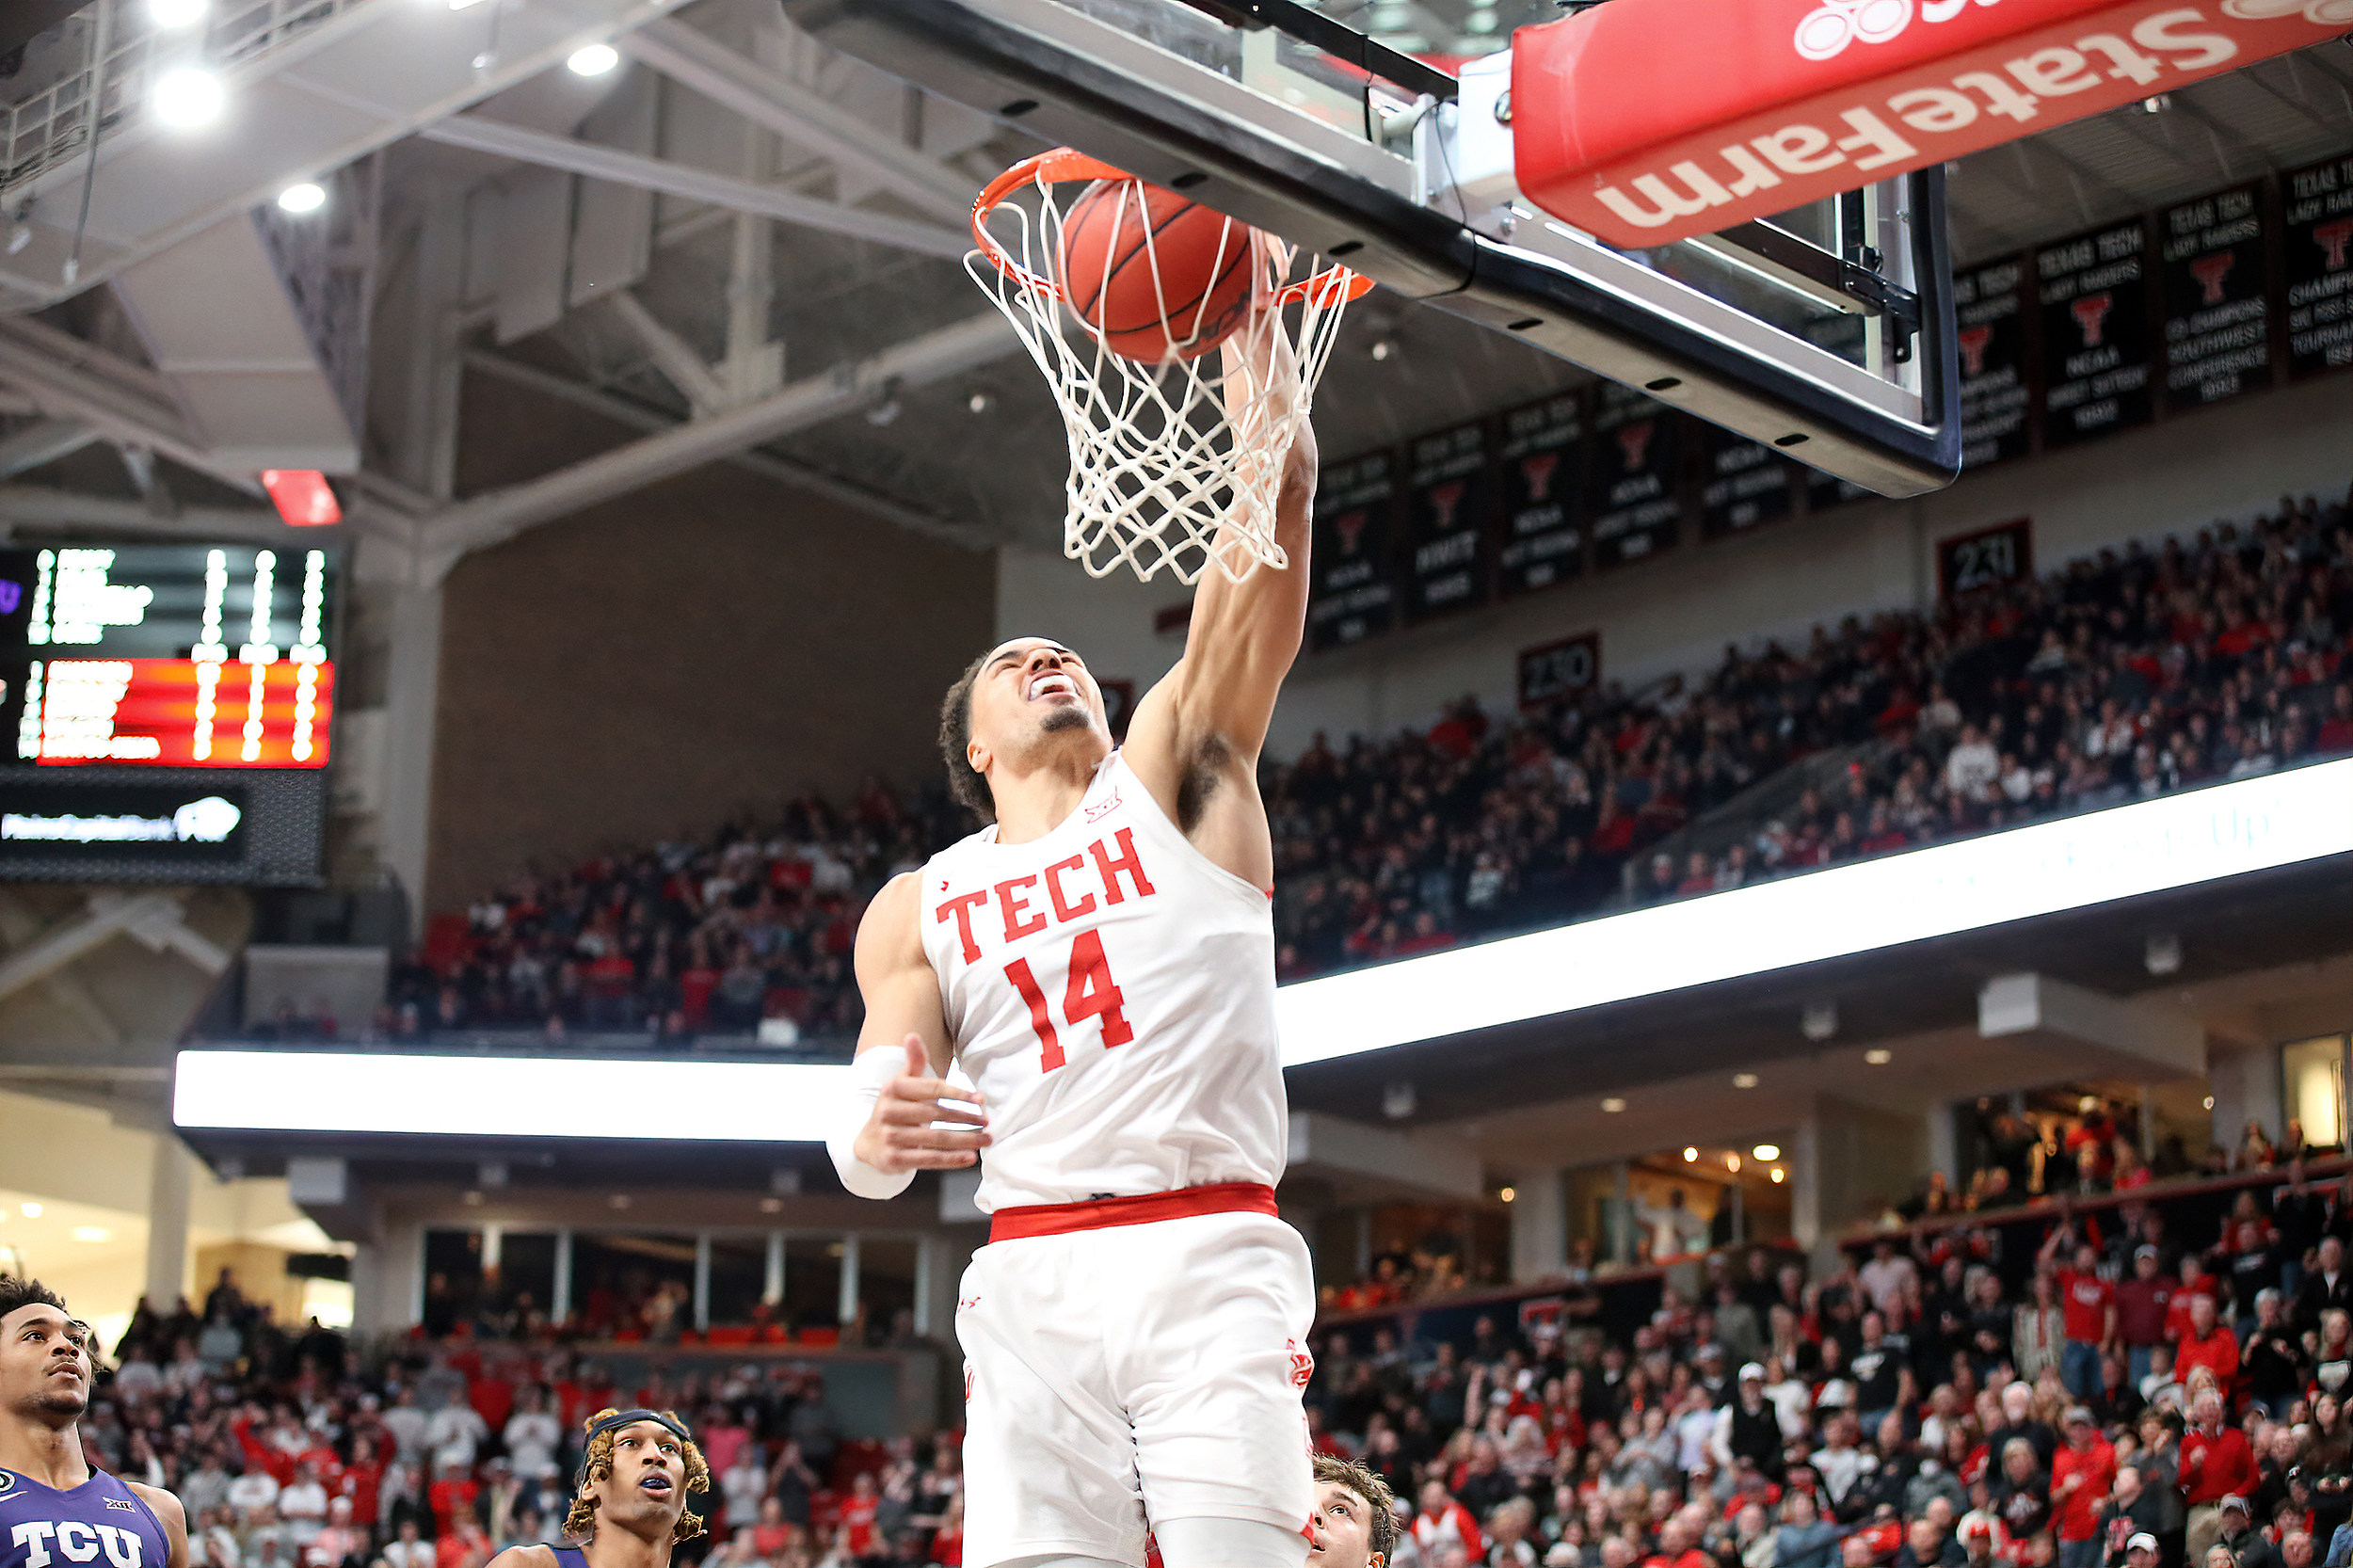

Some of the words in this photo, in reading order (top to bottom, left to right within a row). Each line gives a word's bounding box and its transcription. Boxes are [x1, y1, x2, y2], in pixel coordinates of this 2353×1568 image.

[936, 826, 1157, 966] TECH
[1004, 928, 1135, 1074] 14
[10, 1521, 143, 1568] TCU
